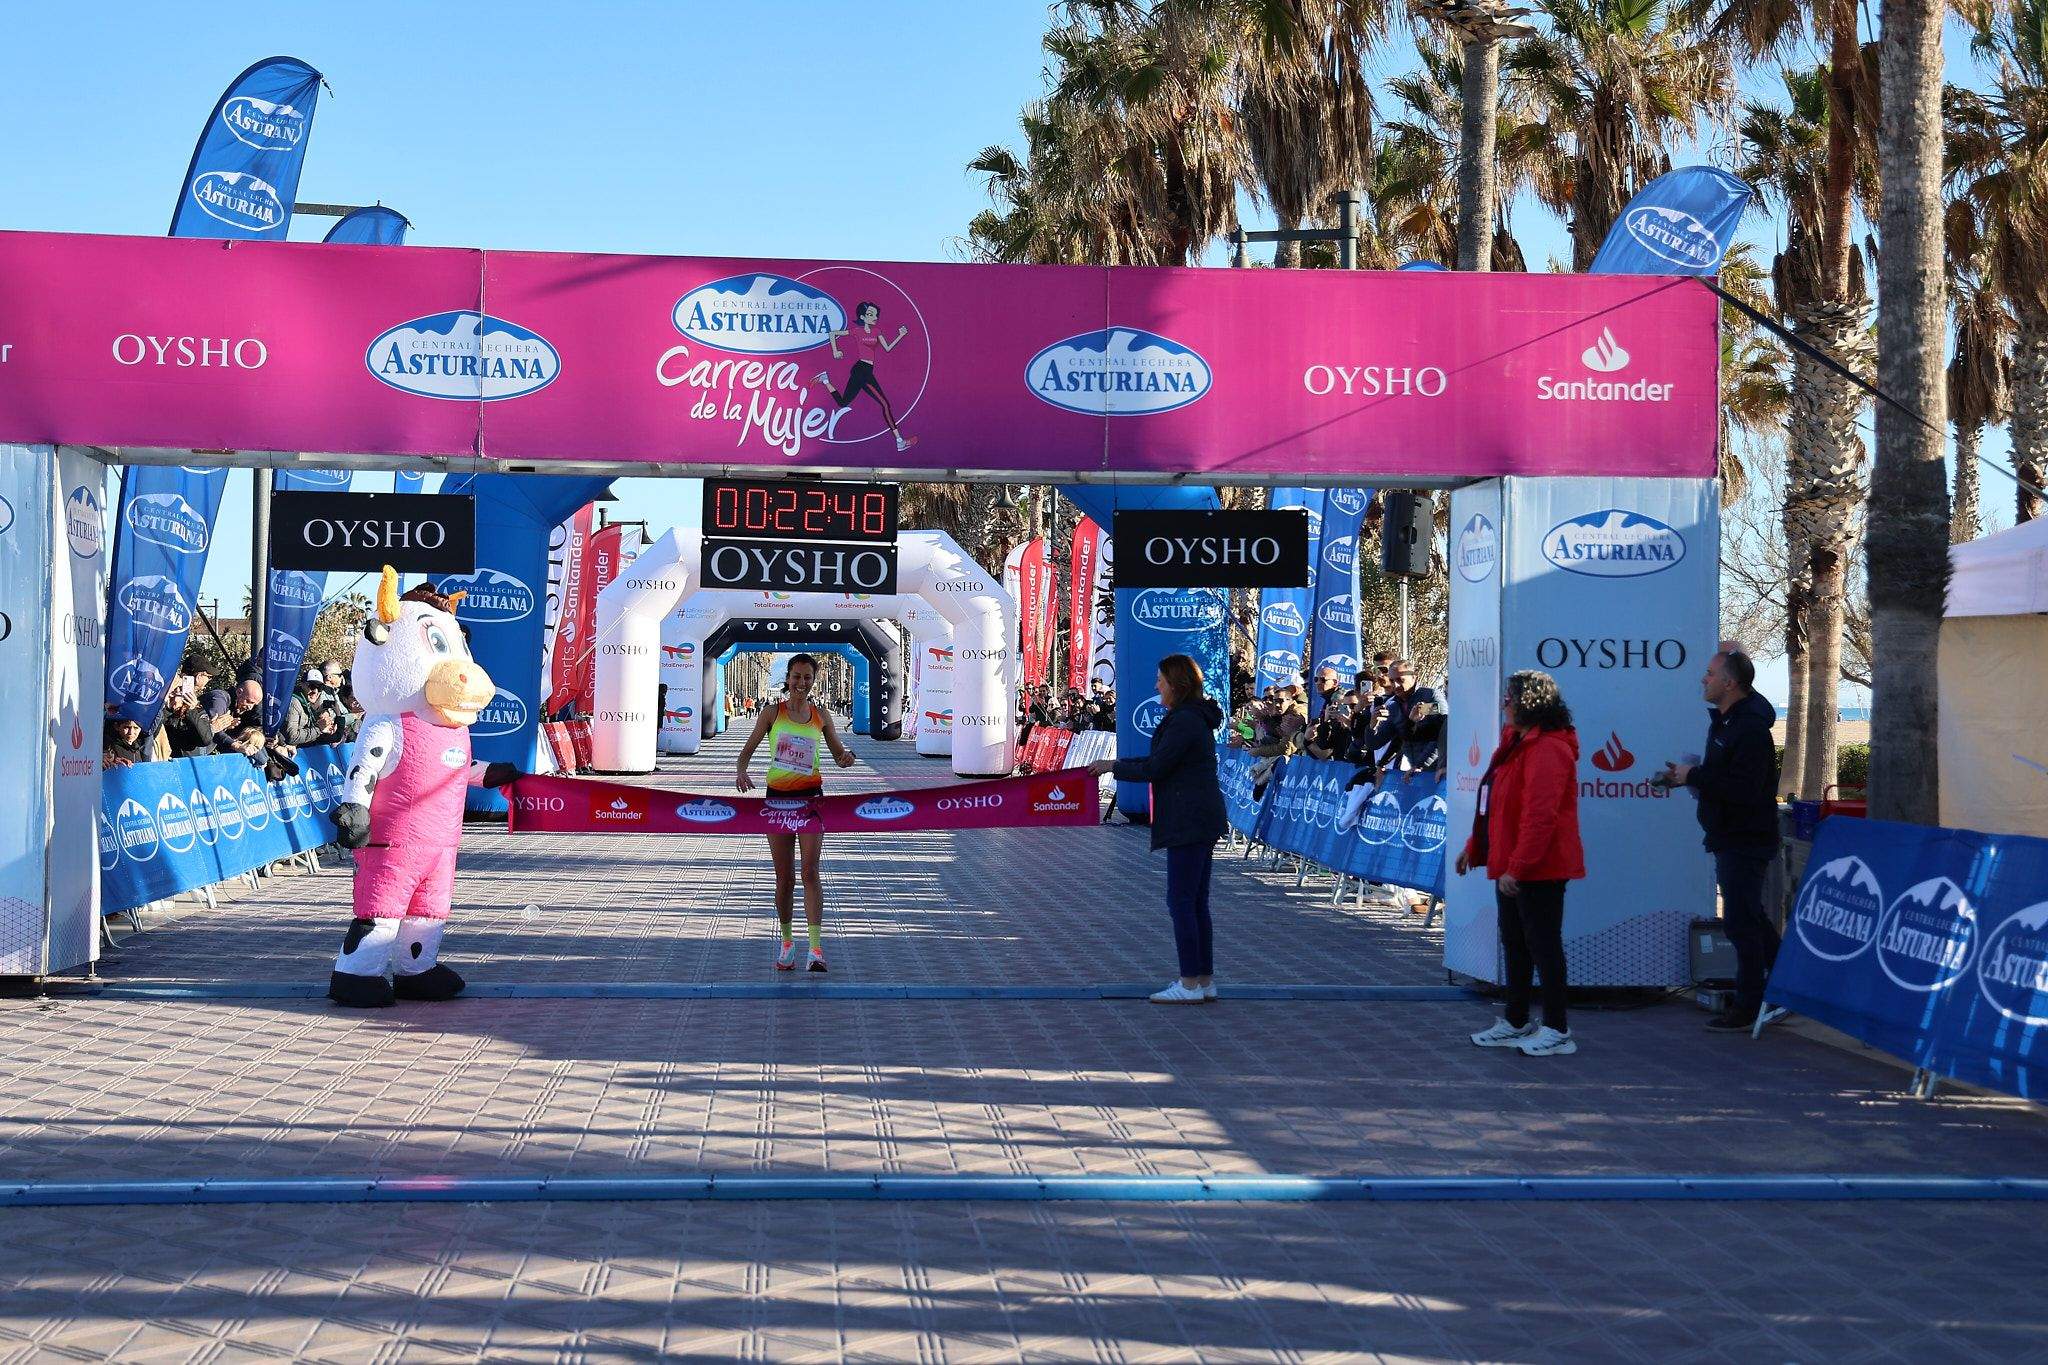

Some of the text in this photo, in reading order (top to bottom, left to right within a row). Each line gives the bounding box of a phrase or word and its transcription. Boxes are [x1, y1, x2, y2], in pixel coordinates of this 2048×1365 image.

[685, 301, 833, 334] ASTURIANA
[713, 300, 828, 310] CENTRAL LECHERA
[112, 333, 268, 369] OYSHO
[412, 340, 472, 350] CENTRAL
[381, 341, 546, 379] ASTURIANA
[656, 345, 800, 391] Carrera
[1069, 357, 1192, 367] CENTRAL LECHERA
[1039, 359, 1197, 392] ASTURIANA
[1303, 365, 1447, 397] OYSHO
[1536, 375, 1674, 401] Santander
[690, 387, 852, 456] de la Mujer
[716, 487, 886, 534] 00:22:48
[303, 518, 446, 549] OYSHO
[1574, 532, 1620, 541] CENTRAL
[1144, 537, 1280, 565] OYSHO
[1460, 542, 1494, 567] ASTURIANA
[1553, 534, 1676, 561] ASTURIANA
[565, 530, 583, 619] Santander
[711, 546, 888, 588] OYSHO
[275, 583, 315, 604] URIANA
[626, 579, 676, 591] OYSHO
[935, 581, 984, 592] OYSHO
[1075, 537, 1091, 626] Santander
[443, 587, 528, 611] TURIANA
[1138, 599, 1220, 619] ASTURIA
[744, 621, 842, 632] VOLVO
[602, 644, 648, 655] OYSHO
[962, 649, 1007, 660] OYSHO
[1454, 636, 1496, 669] OYSHO
[1536, 637, 1687, 670] OYSHO
[1075, 652, 1086, 696] ports
[880, 661, 889, 731] VOLVO
[476, 709, 521, 725] RIANA
[599, 711, 646, 722] OYSHO
[1576, 778, 1670, 798] ntander
[514, 797, 565, 811] YSHO
[595, 810, 643, 819] Santander
[681, 806, 732, 816] ASTURIANA
[859, 804, 911, 815] ASTURIANA
[937, 794, 1003, 810] OYSHO
[1034, 801, 1080, 811] Santander
[780, 816, 810, 831] Mujer
[1800, 884, 1872, 942] ASTURIANA
[1881, 910, 1968, 970] ASTURIANA
[1985, 936, 2048, 992] ASTUR
